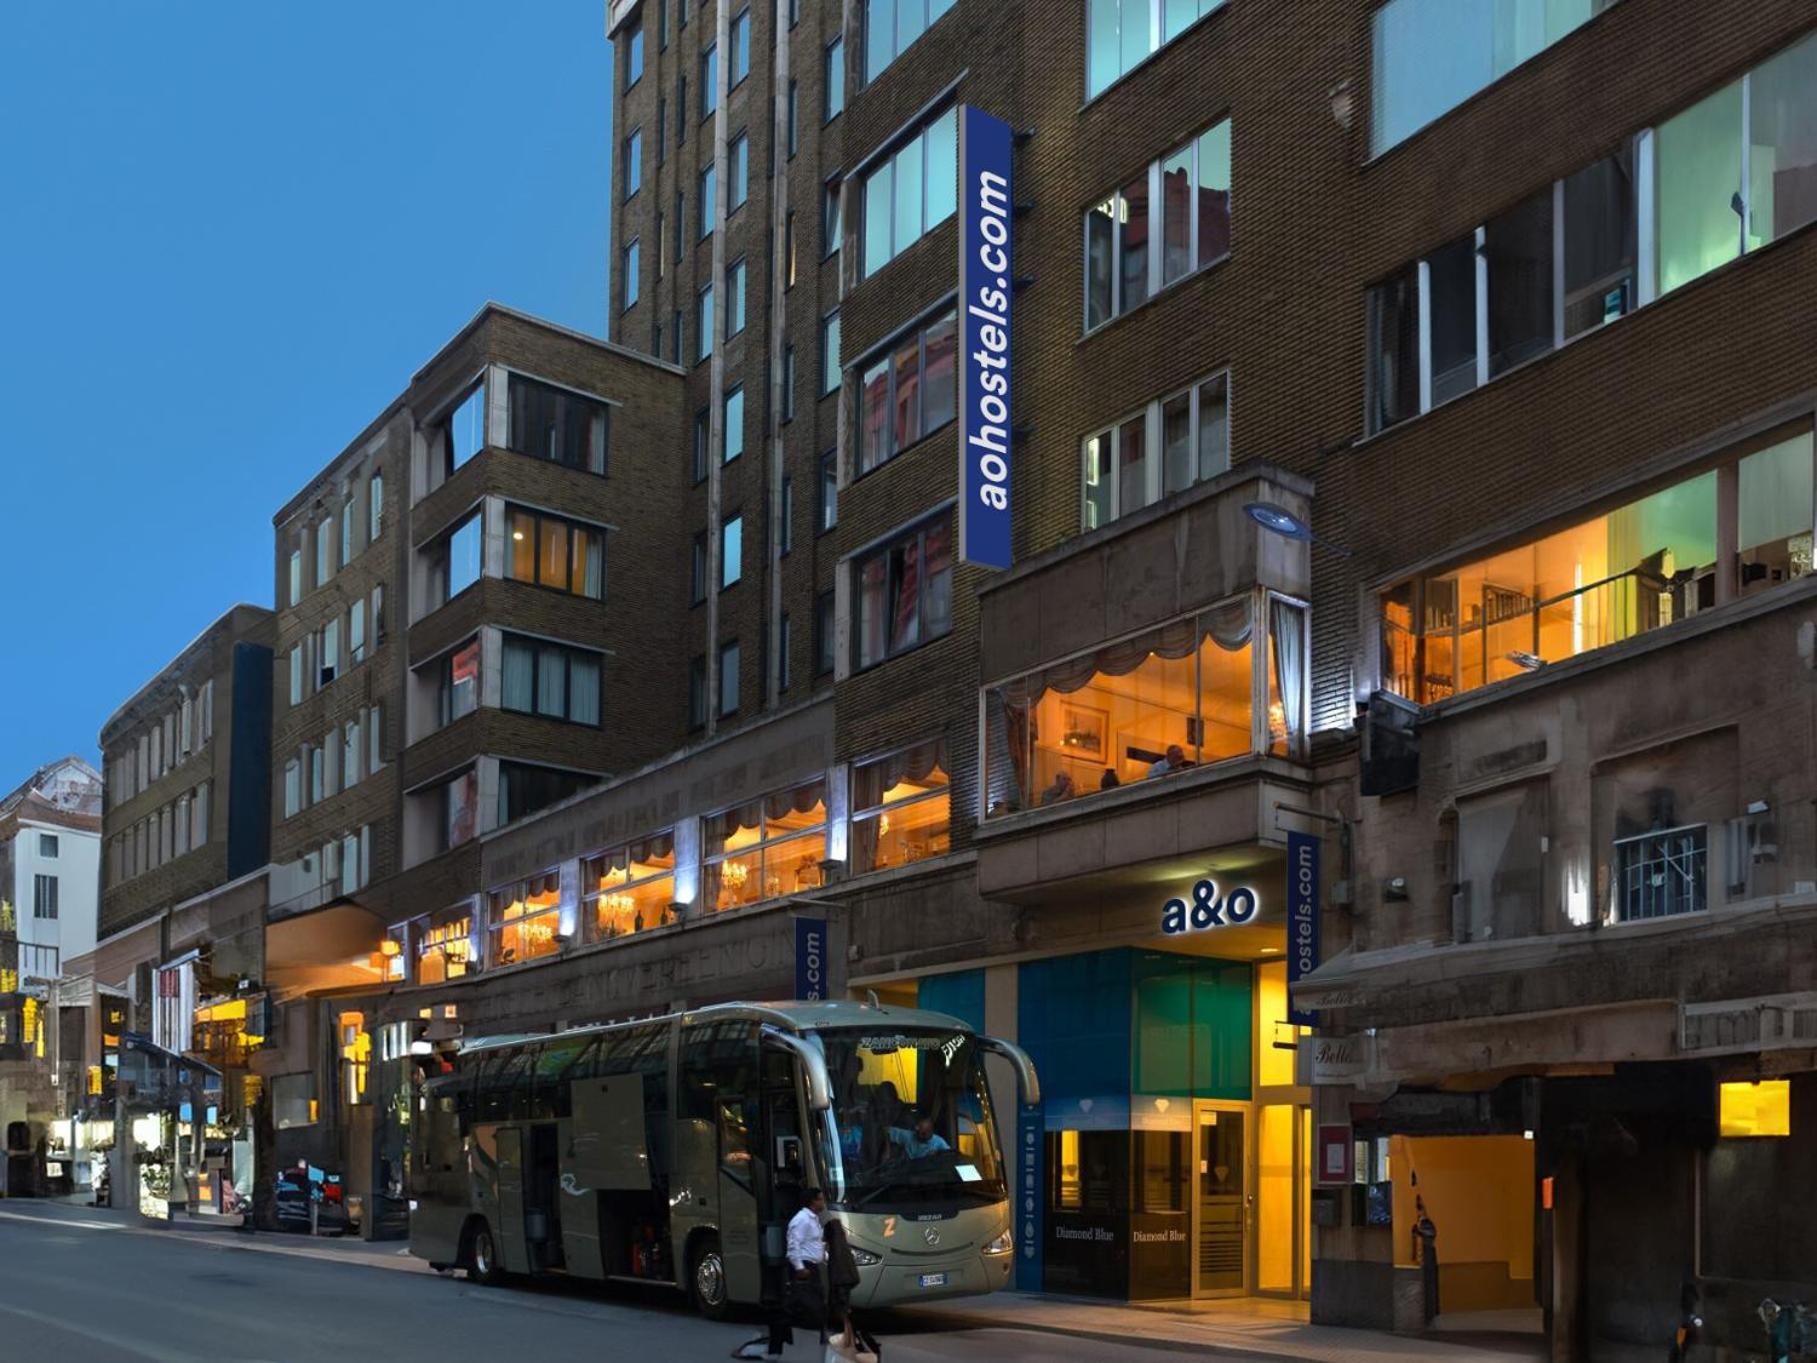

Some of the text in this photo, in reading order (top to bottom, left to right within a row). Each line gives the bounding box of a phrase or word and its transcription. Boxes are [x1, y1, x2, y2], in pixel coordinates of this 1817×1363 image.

[968, 169, 1009, 511] aohostels.com
[1161, 878, 1258, 935] a&o
[883, 1216, 896, 1238] Z
[1055, 1226, 1114, 1241] Diamond Blue
[1133, 1229, 1186, 1242] Diamond Blue
